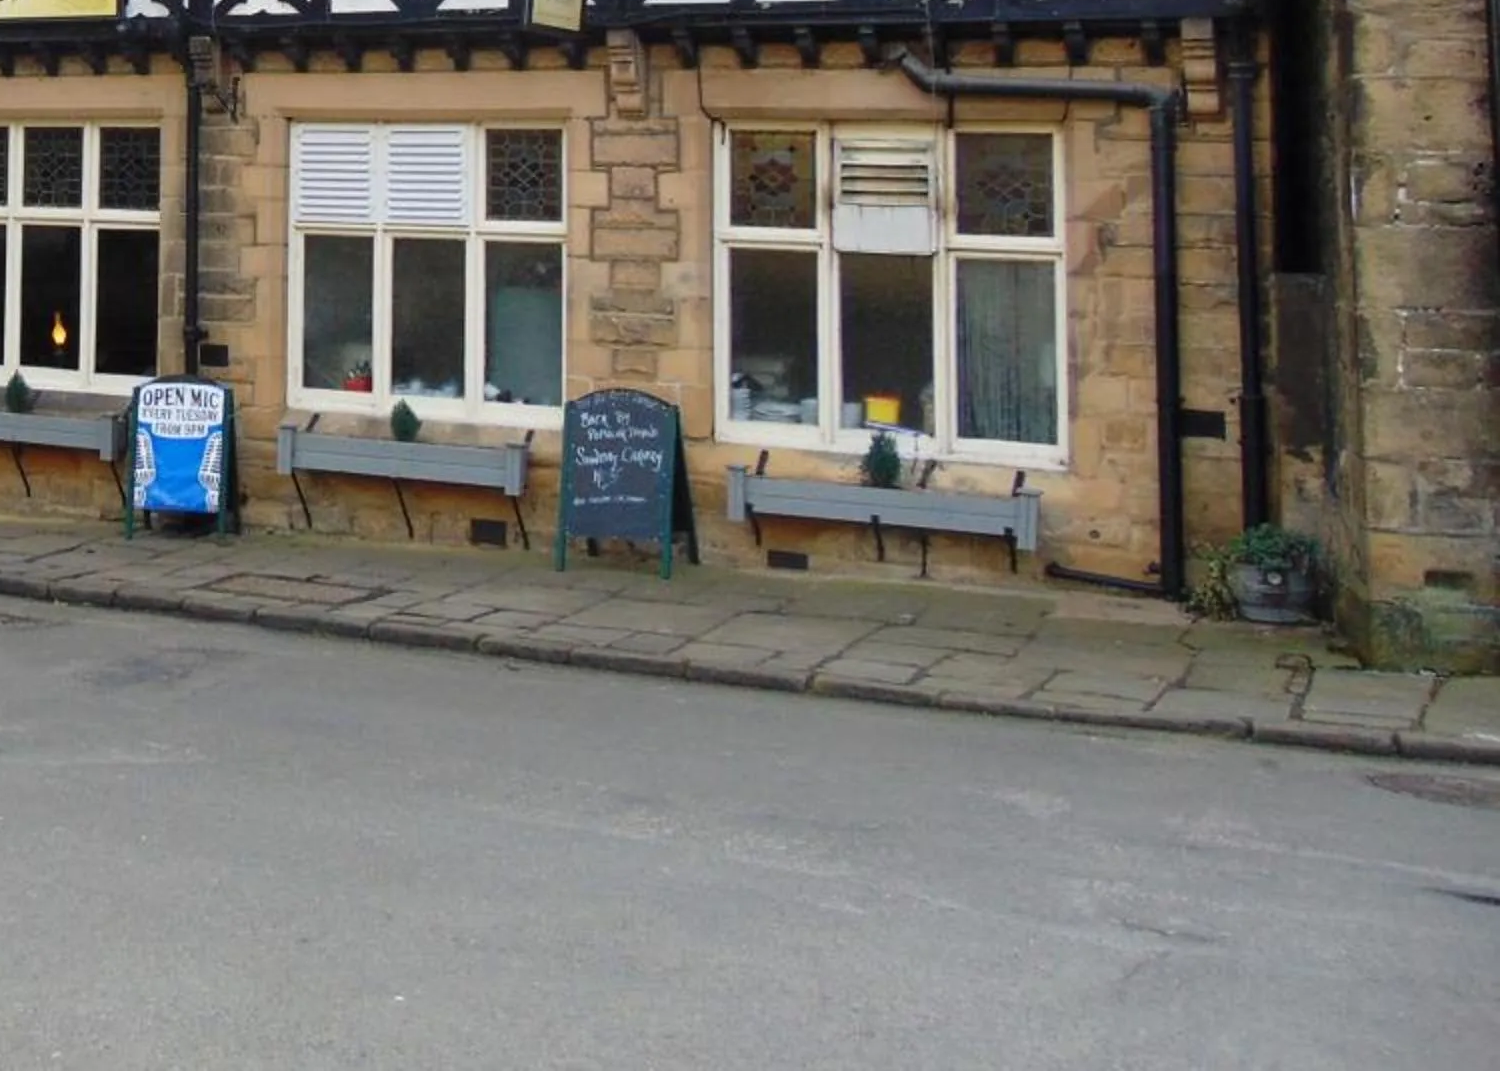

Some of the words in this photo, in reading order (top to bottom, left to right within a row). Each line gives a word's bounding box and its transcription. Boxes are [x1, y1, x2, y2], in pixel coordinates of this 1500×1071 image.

[143, 388, 185, 406] OPEN
[191, 389, 219, 408] MIC
[143, 407, 171, 420] EVERY
[175, 408, 219, 422] TUESDAY
[156, 423, 181, 435] FROM
